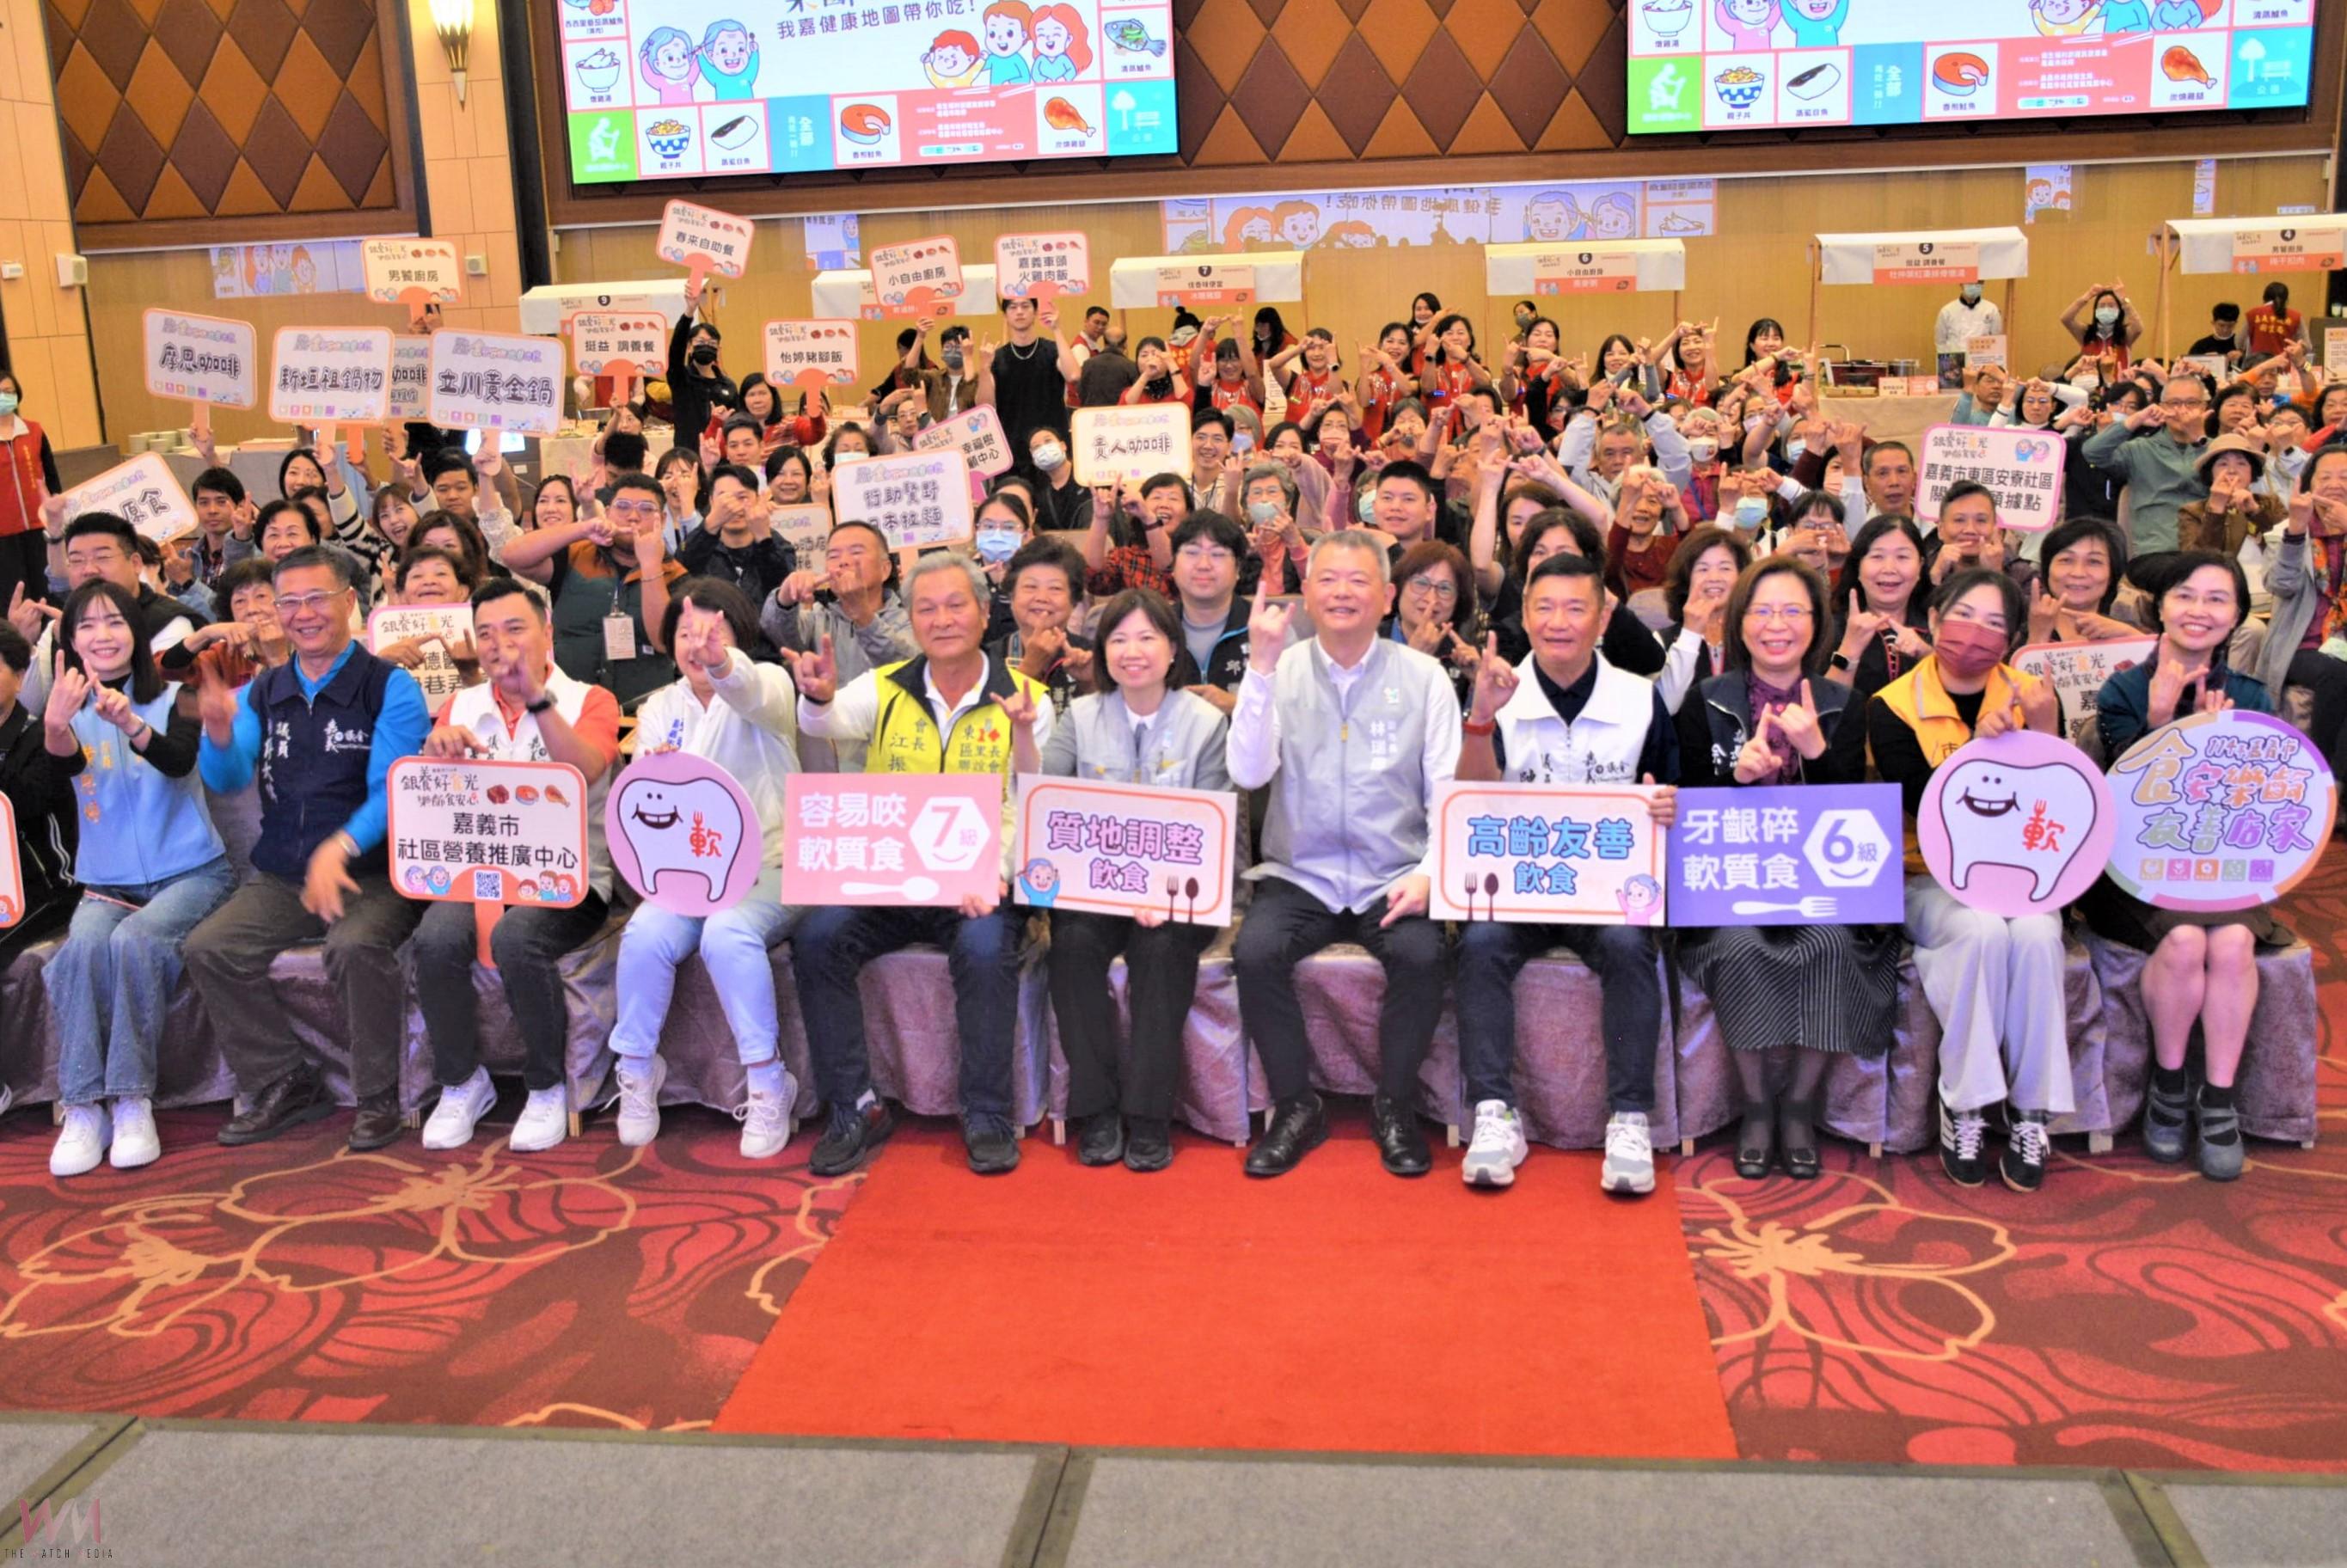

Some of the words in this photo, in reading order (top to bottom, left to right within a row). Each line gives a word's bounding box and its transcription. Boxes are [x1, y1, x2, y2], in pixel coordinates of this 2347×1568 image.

[676, 230, 736, 256] 春來自助餐
[1582, 254, 1590, 263] 6
[1922, 243, 1929, 253] 5
[889, 266, 946, 287] 小自由廚房
[1019, 255, 1067, 268] 嘉義車頭
[1019, 269, 1068, 283] 火雞肉飯
[1202, 266, 1209, 276] 7
[160, 343, 241, 379] 摩恩咖啡
[585, 340, 610, 352] 挺益
[617, 340, 654, 352] 調養餐
[437, 369, 555, 407] 立川黃金鍋
[1094, 432, 1172, 461] 貴人咖啡
[453, 812, 519, 837] 嘉義市
[799, 793, 907, 829] 容易咬
[929, 805, 962, 849] 7
[1682, 807, 1799, 844] 牙齦碎
[959, 828, 979, 848] 級
[1047, 809, 1204, 866] 質地調整
[1466, 816, 1633, 860] 高齡友善
[1821, 818, 1853, 864] 6
[2136, 801, 2313, 854] 友善店家
[398, 838, 578, 868] 社區營養推廣中心
[798, 836, 906, 873] 軟質食
[1857, 842, 1878, 863] 級
[1089, 859, 1149, 894] 飲食
[1513, 861, 1577, 896] 飲食
[1682, 853, 1799, 891] 軟質食
